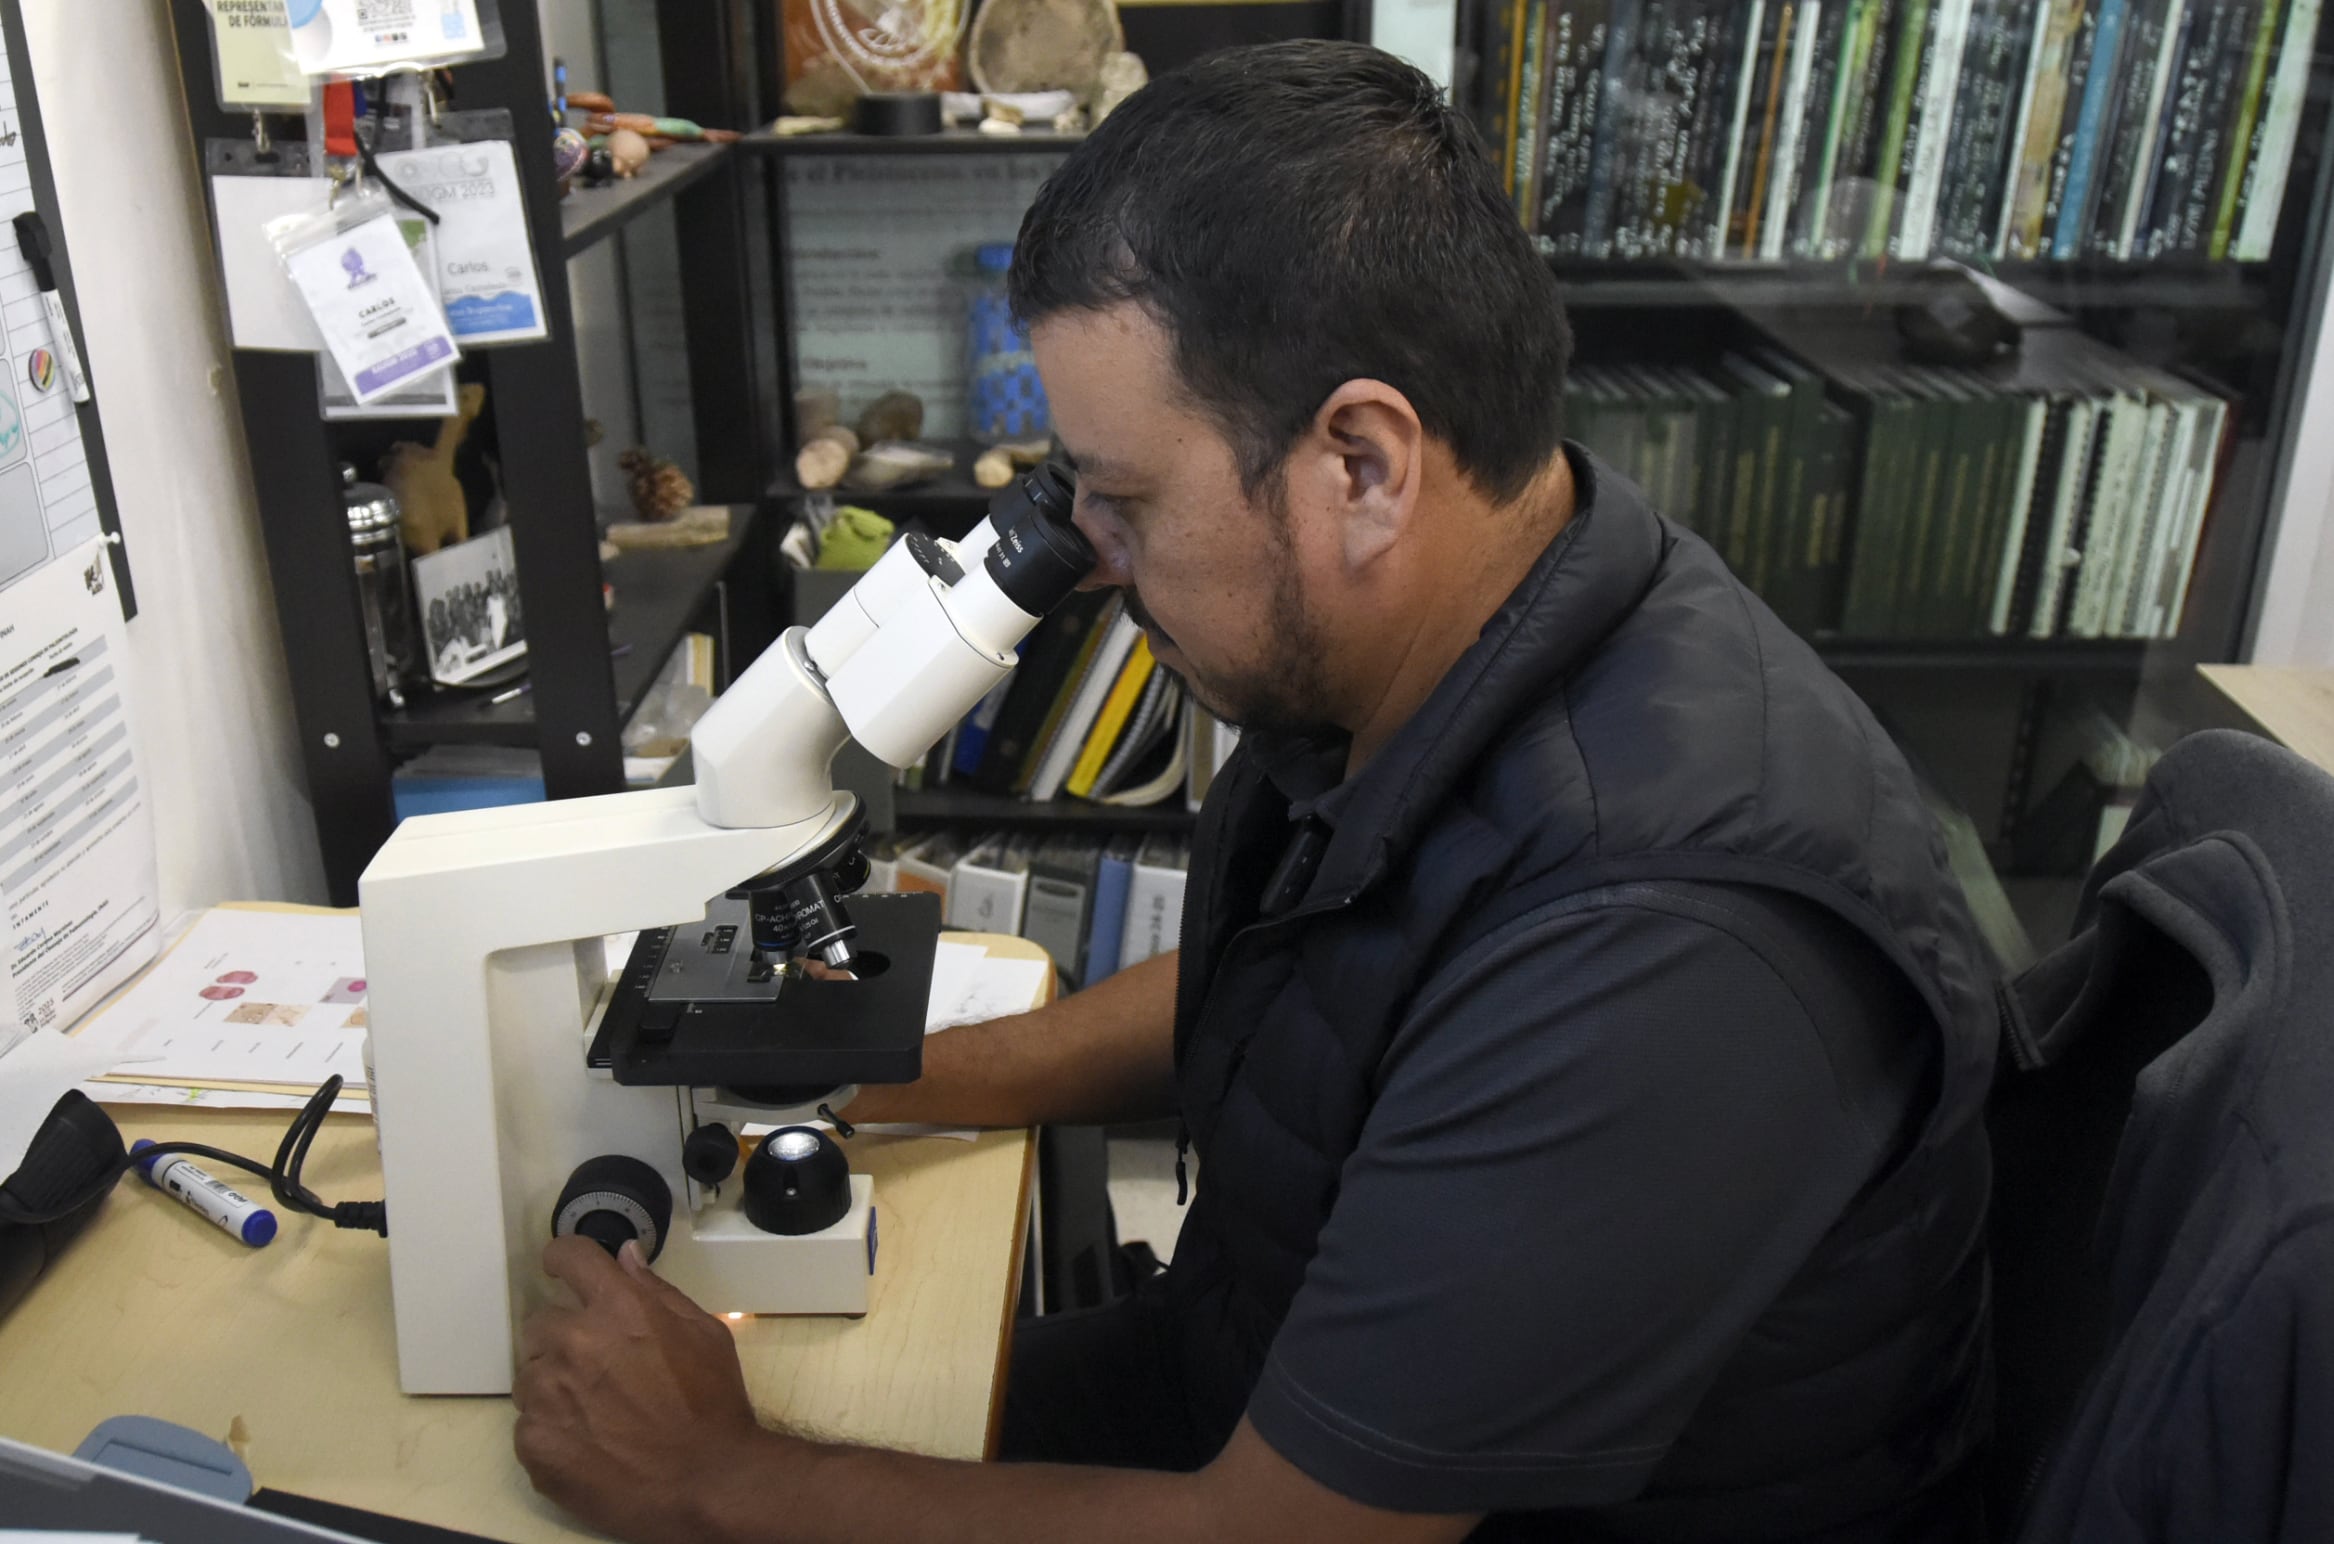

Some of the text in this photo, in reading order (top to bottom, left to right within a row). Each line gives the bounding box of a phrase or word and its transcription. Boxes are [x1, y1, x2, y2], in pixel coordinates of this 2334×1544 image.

[229, 15, 241, 27] DE
[447, 261, 489, 276] Carlos
[358, 297, 396, 319] CARLOS
